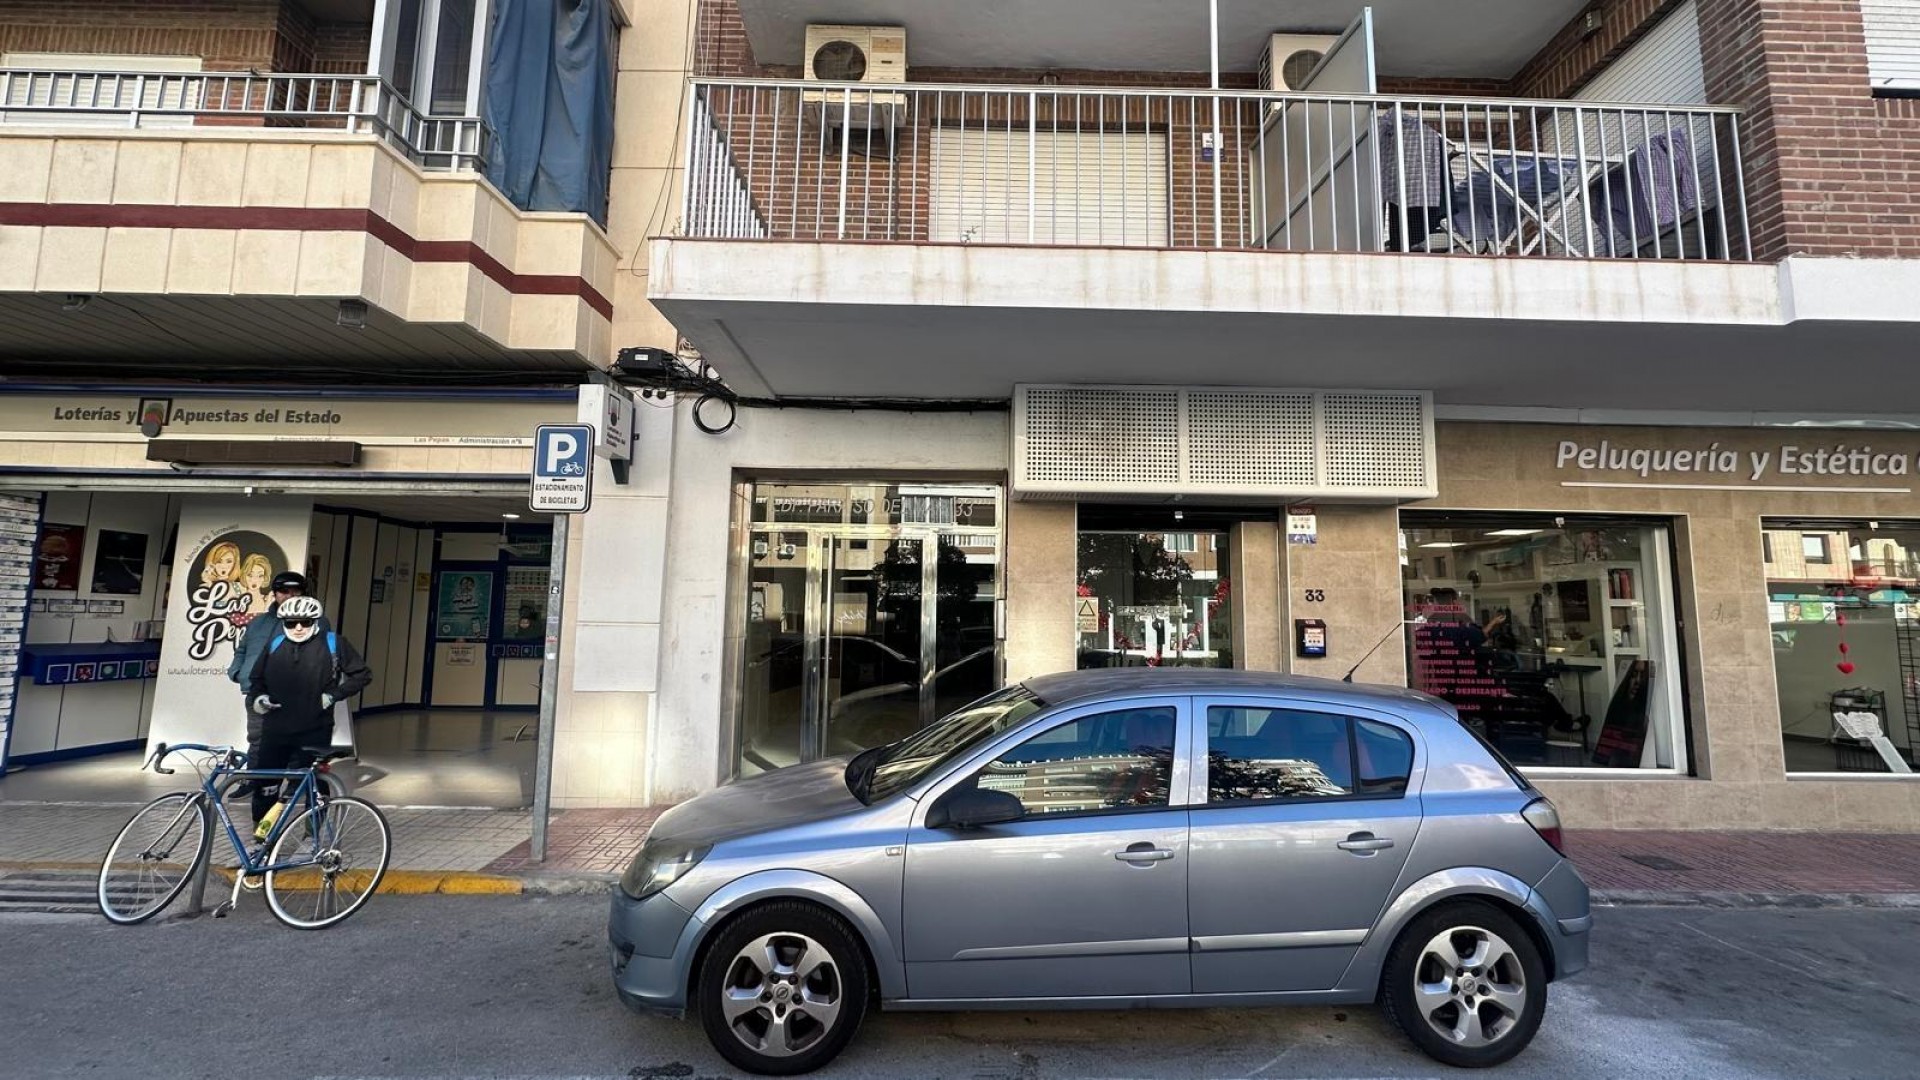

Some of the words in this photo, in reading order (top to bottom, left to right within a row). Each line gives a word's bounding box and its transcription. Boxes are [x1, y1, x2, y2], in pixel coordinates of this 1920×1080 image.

[54, 406, 121, 421] Loterías
[126, 409, 137, 424] y
[173, 408, 249, 424] Apuestas
[254, 408, 279, 423] del
[285, 409, 341, 424] Estado
[547, 433, 577, 472] P
[1556, 440, 1738, 477] Peluquería
[1749, 450, 1770, 480] y
[1779, 445, 1908, 475] Estética
[535, 483, 584, 492] ESTACIONAMIENTO
[540, 496, 547, 504] DE
[548, 496, 577, 504] BICICLETAS
[187, 580, 252, 625] Las
[1305, 589, 1325, 602] 33
[189, 619, 247, 660] Pep
